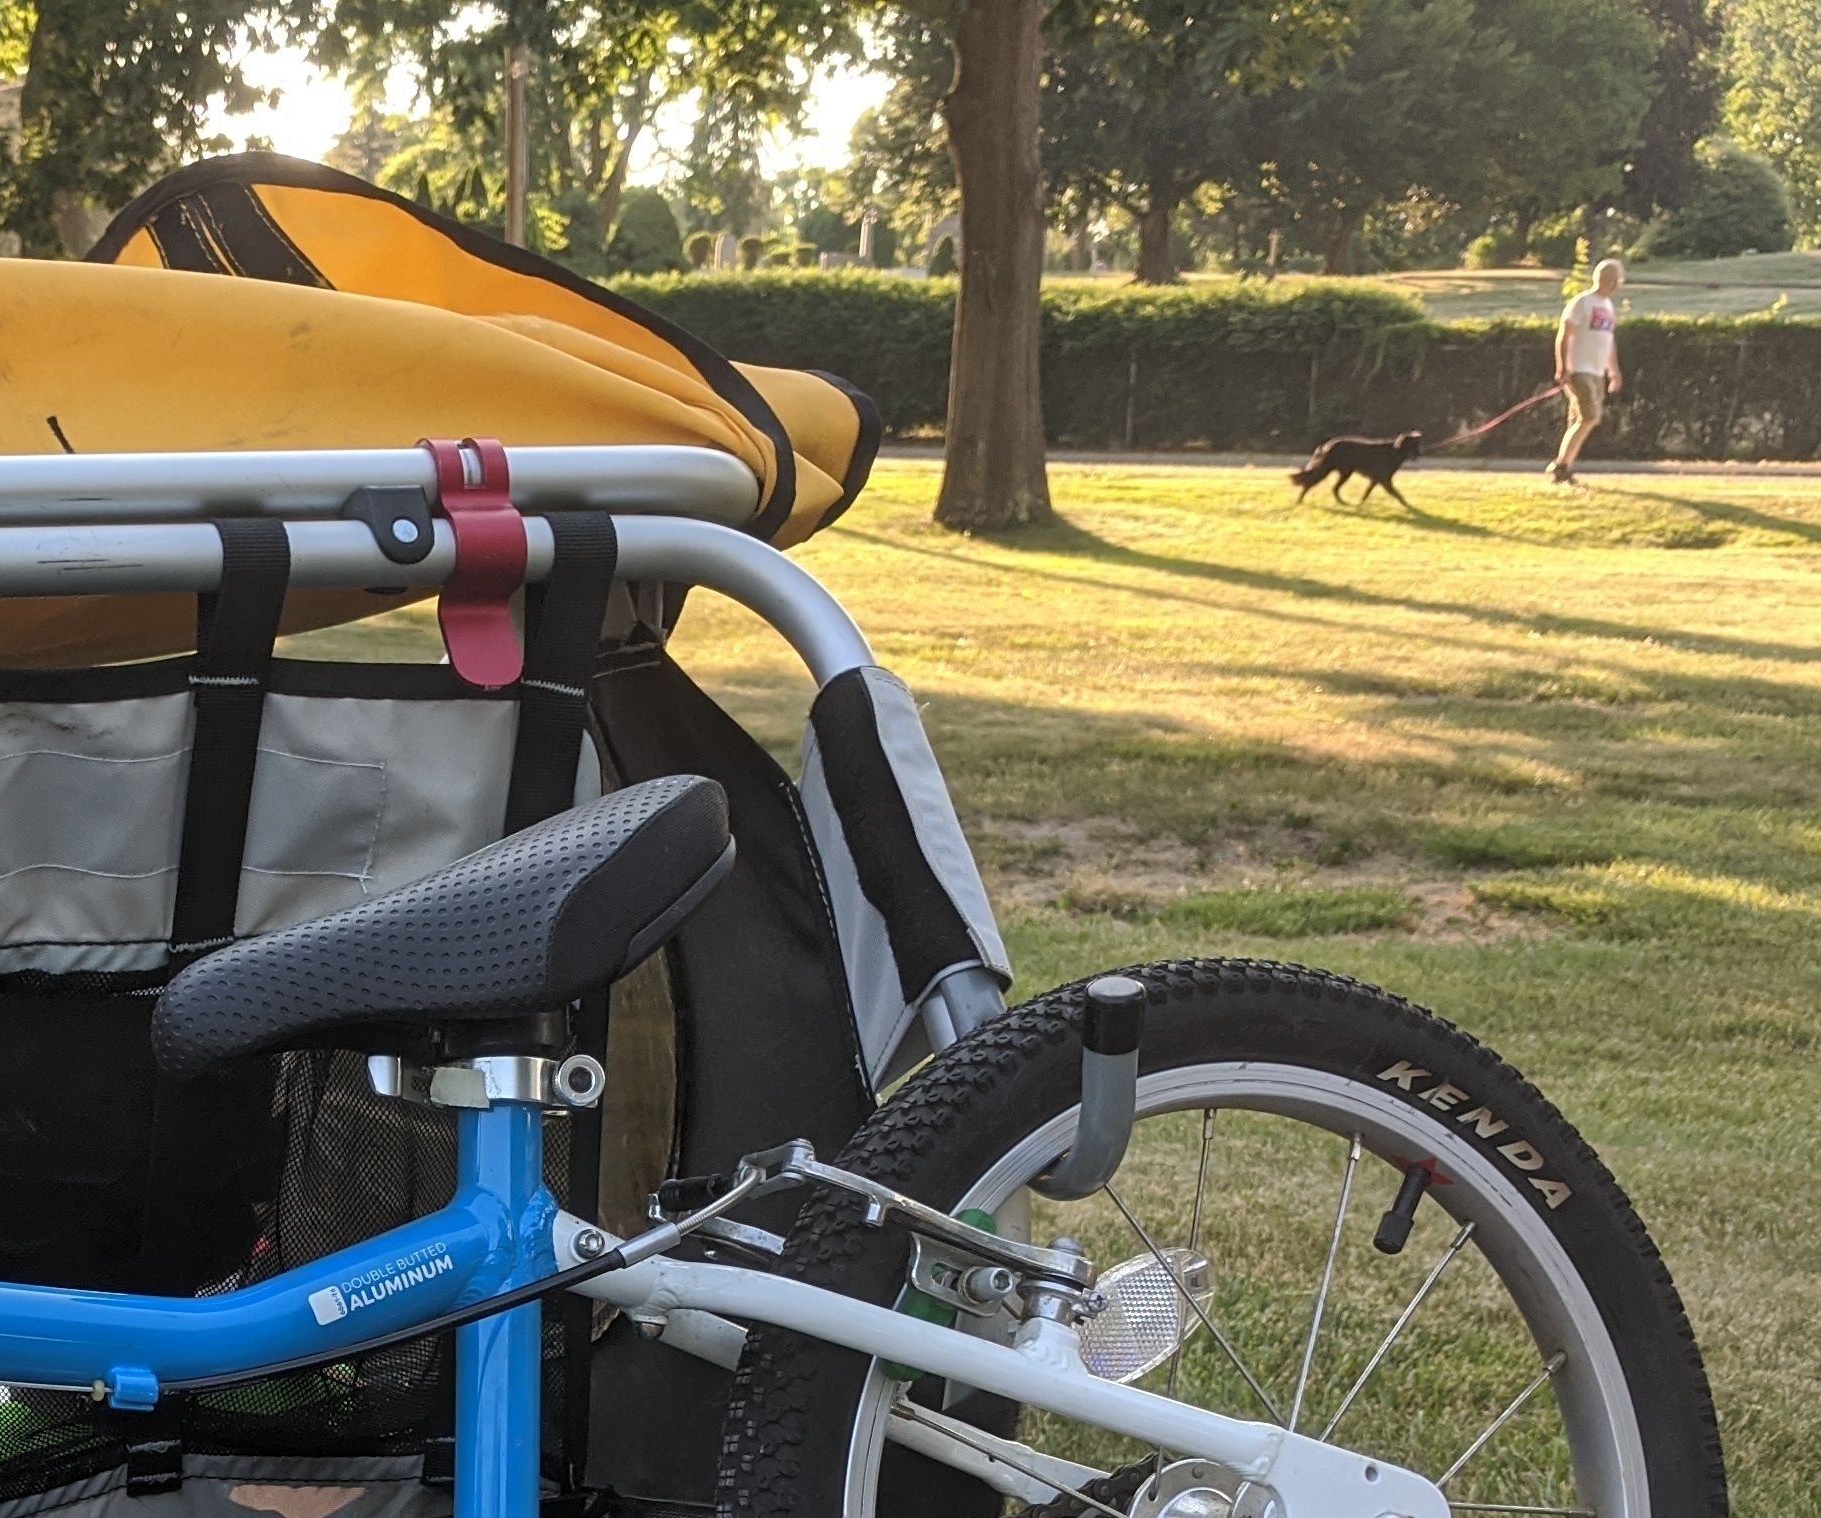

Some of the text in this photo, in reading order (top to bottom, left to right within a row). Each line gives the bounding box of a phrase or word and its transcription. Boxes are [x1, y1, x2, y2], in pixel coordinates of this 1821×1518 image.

[1375, 1059, 1573, 1211] KENDA
[341, 1242, 447, 1294] DOUBLE BUTTED
[350, 1254, 454, 1312] ALUMINUM
